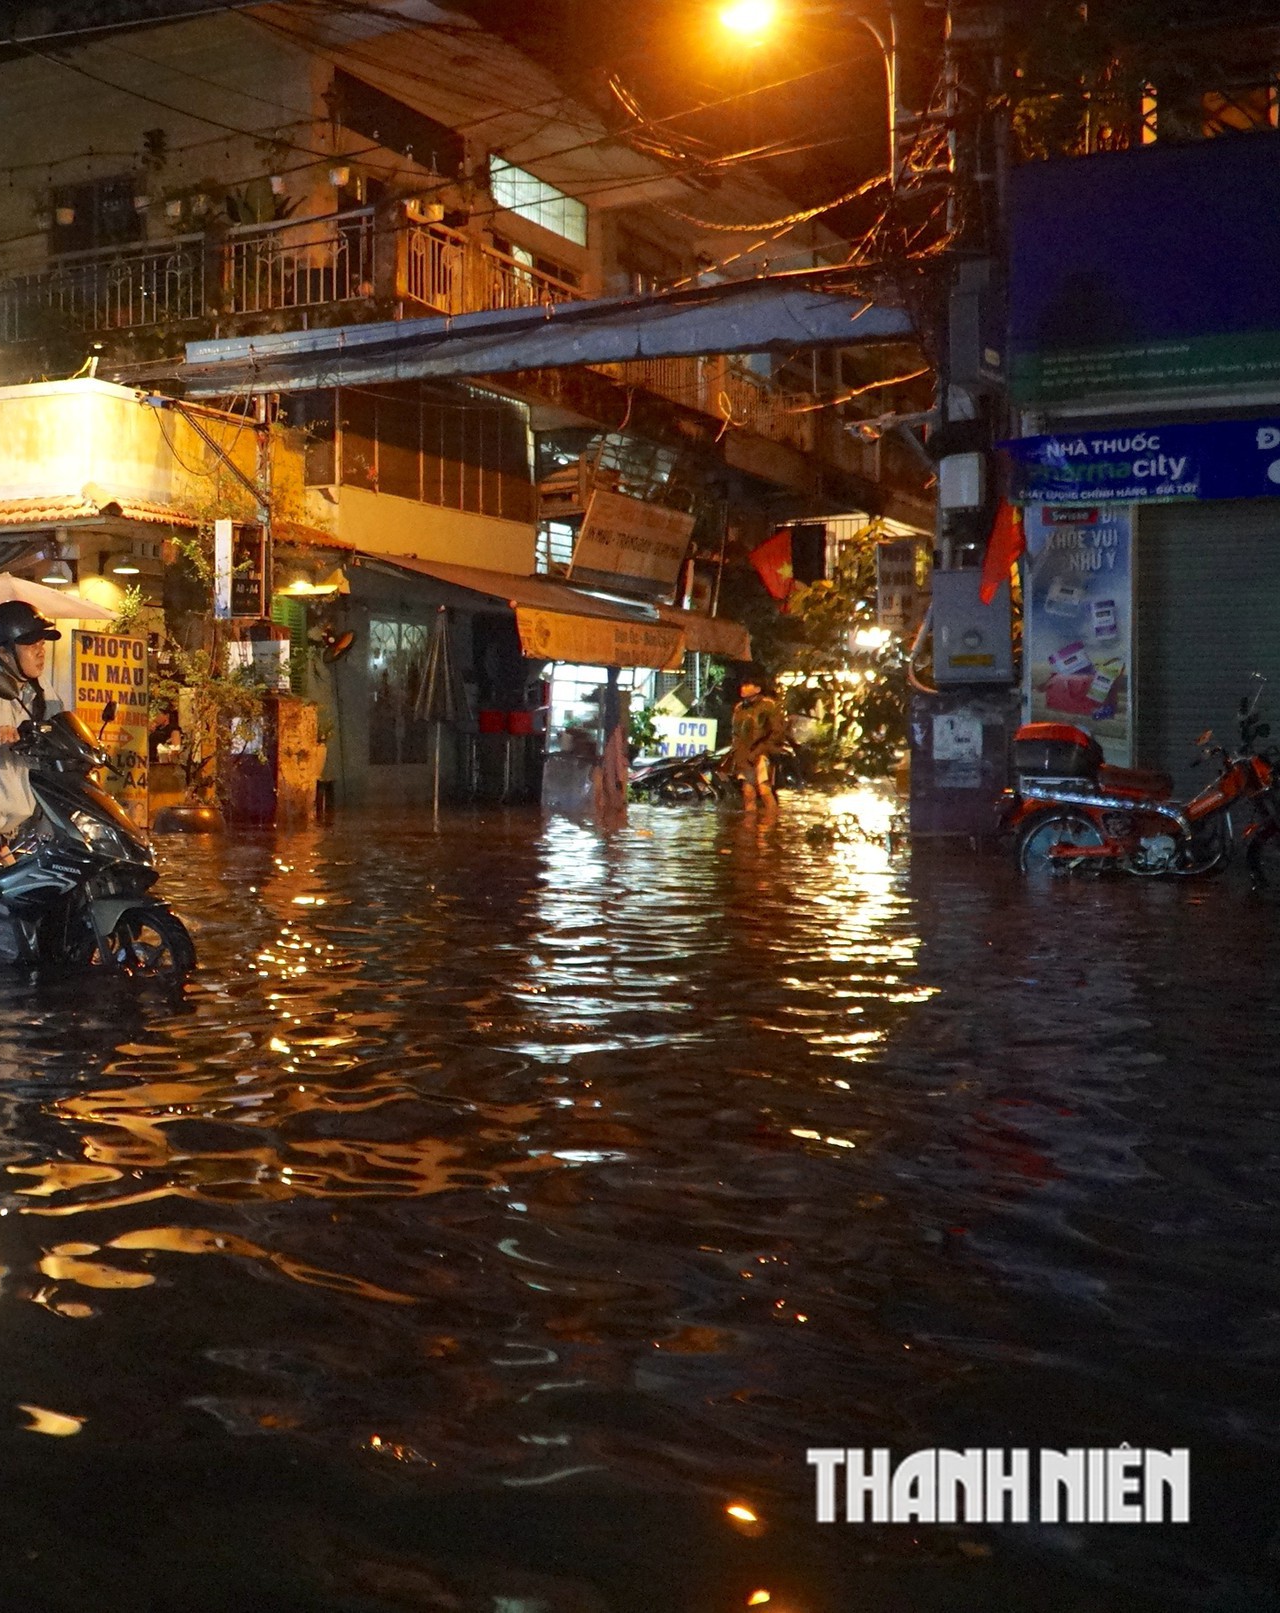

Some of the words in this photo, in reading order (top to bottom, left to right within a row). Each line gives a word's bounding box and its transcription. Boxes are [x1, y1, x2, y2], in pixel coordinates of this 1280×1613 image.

[1046, 439, 1088, 458] NHÀ
[1091, 432, 1160, 454] THUỐC
[81, 635, 144, 661] PHOTO
[81, 663, 99, 682] IN
[106, 661, 144, 686] MÀU
[78, 687, 113, 703] SCAN
[118, 687, 148, 707] MÀU
[679, 722, 707, 737] OTO
[123, 771, 146, 789] A4
